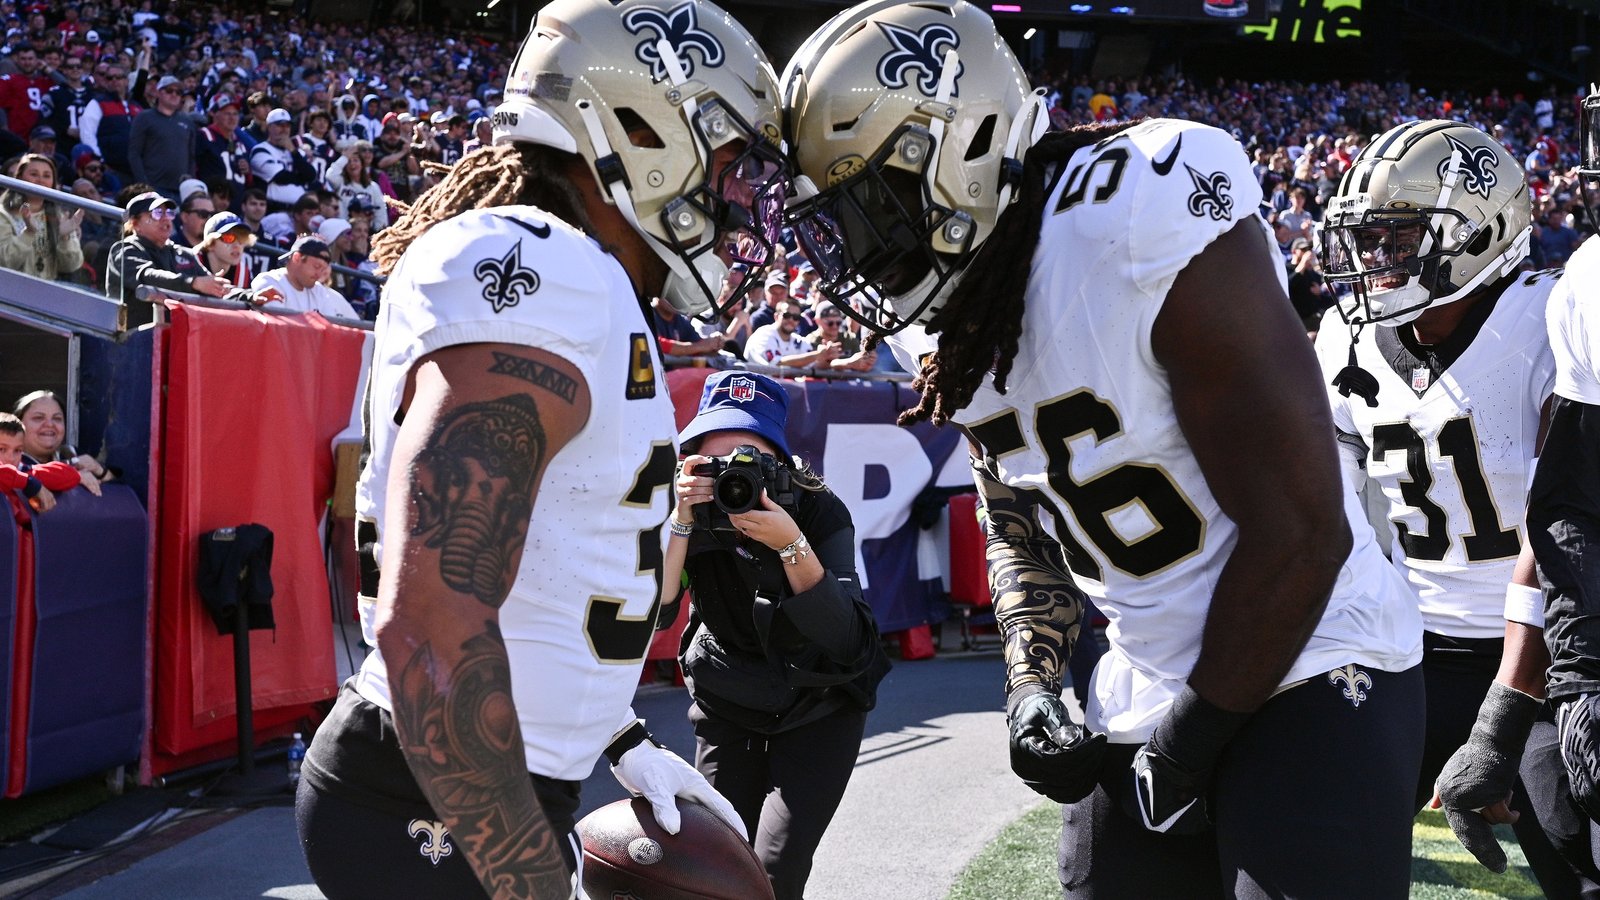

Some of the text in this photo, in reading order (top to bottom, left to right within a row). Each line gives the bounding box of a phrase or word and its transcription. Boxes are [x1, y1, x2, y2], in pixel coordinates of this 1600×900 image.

[27, 87, 41, 110] 9
[632, 338, 653, 383] C
[733, 386, 752, 398] NFL
[1414, 378, 1427, 389] NFL
[964, 386, 1207, 586] 56
[1370, 414, 1524, 564] 31
